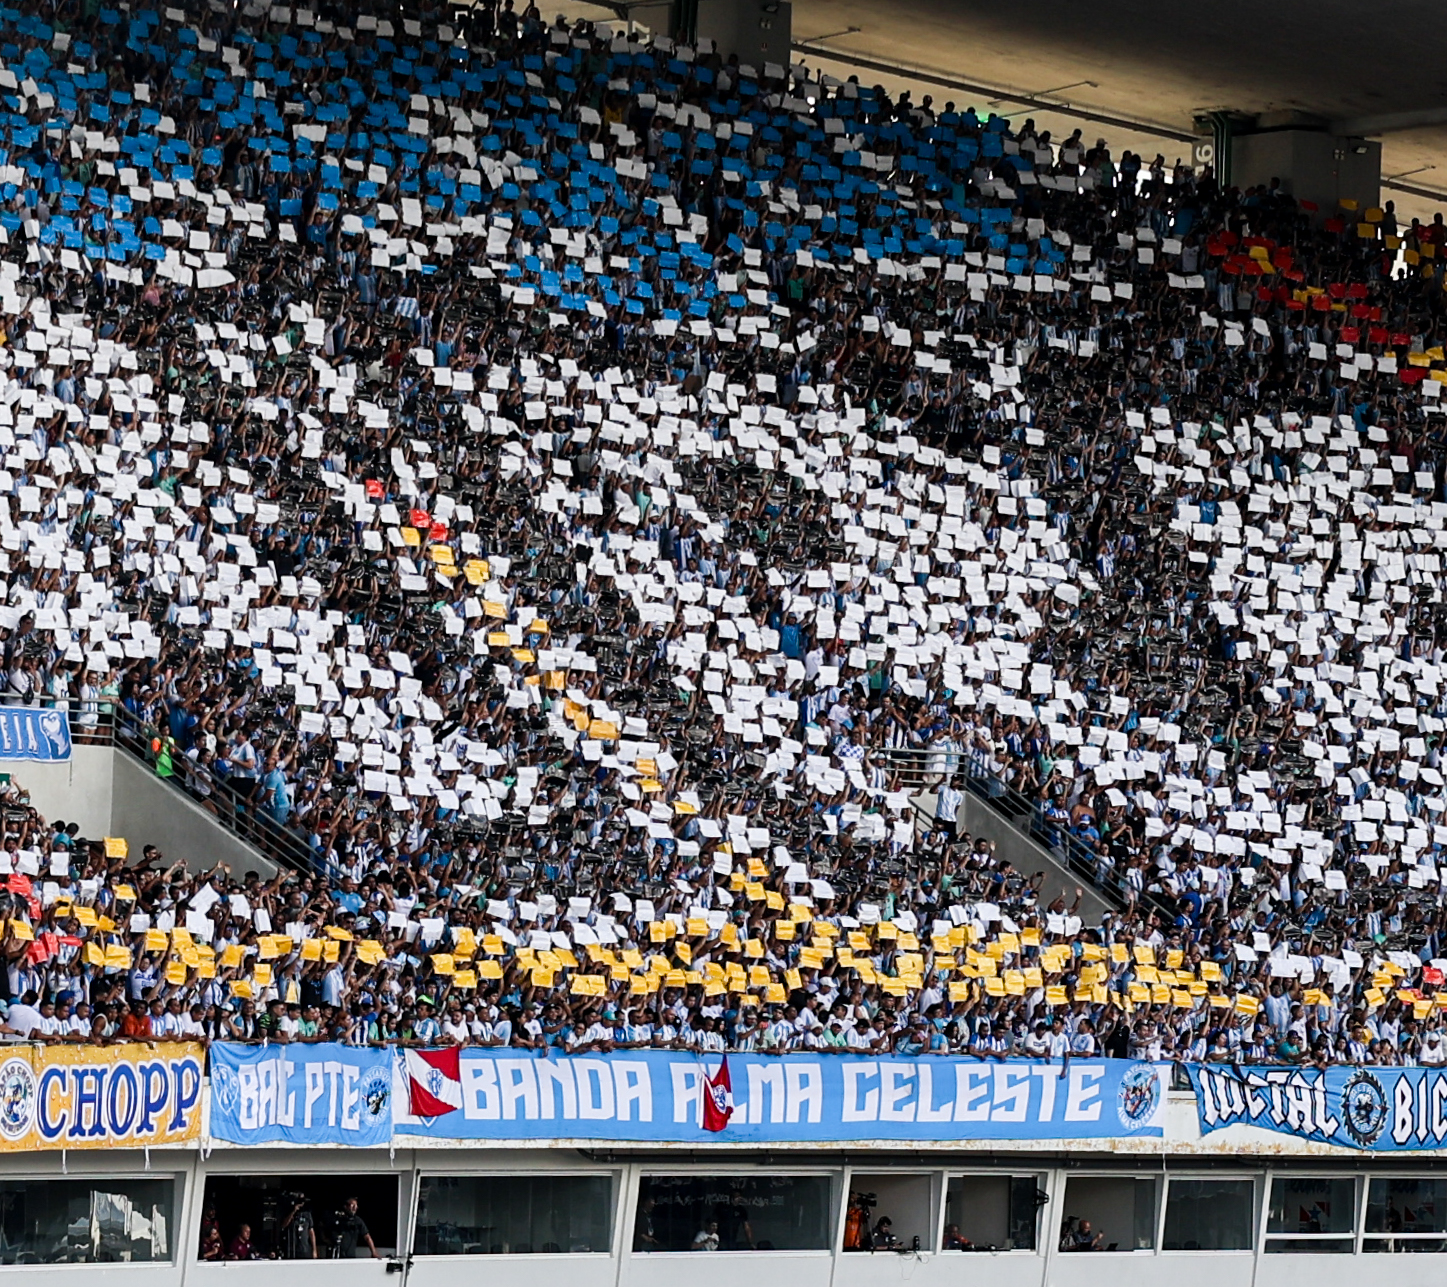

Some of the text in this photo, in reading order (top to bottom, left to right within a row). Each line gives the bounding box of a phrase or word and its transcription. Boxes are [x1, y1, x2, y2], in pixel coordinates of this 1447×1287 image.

[36, 1055, 202, 1143] CHOPP
[305, 1061, 360, 1130] PTE
[462, 1057, 656, 1123] BANDA
[841, 1060, 1106, 1124] CELESTE
